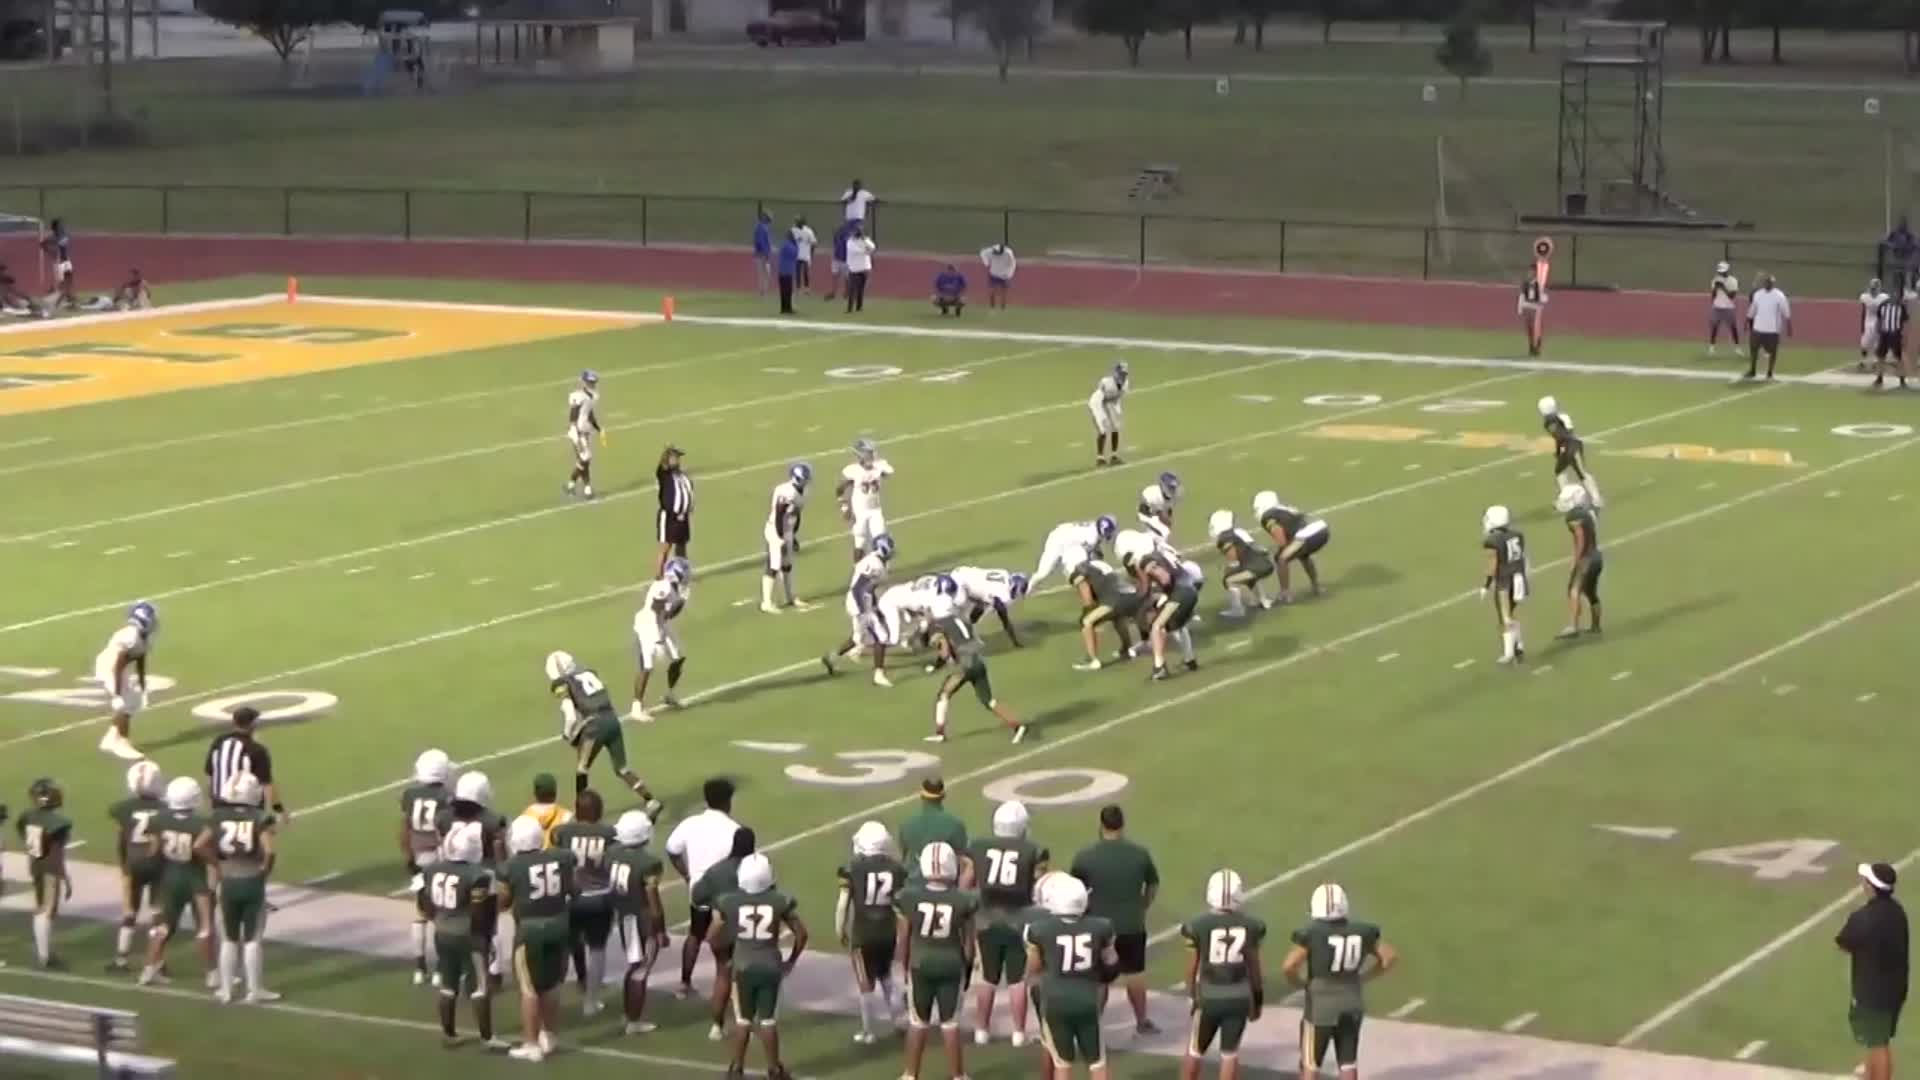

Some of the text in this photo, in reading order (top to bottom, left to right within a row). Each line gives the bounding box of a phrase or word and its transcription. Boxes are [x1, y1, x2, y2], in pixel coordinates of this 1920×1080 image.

[411, 799, 437, 832] 13
[219, 820, 254, 853] 24
[570, 836, 605, 868] 44
[529, 862, 561, 901] 56
[986, 849, 1019, 886] 76
[430, 871, 460, 910] 66
[866, 871, 893, 906] 12
[738, 904, 774, 940] 52
[917, 903, 952, 939] 73
[1056, 933, 1094, 973] 75
[1209, 928, 1247, 963] 62
[1328, 935, 1363, 972] 70
